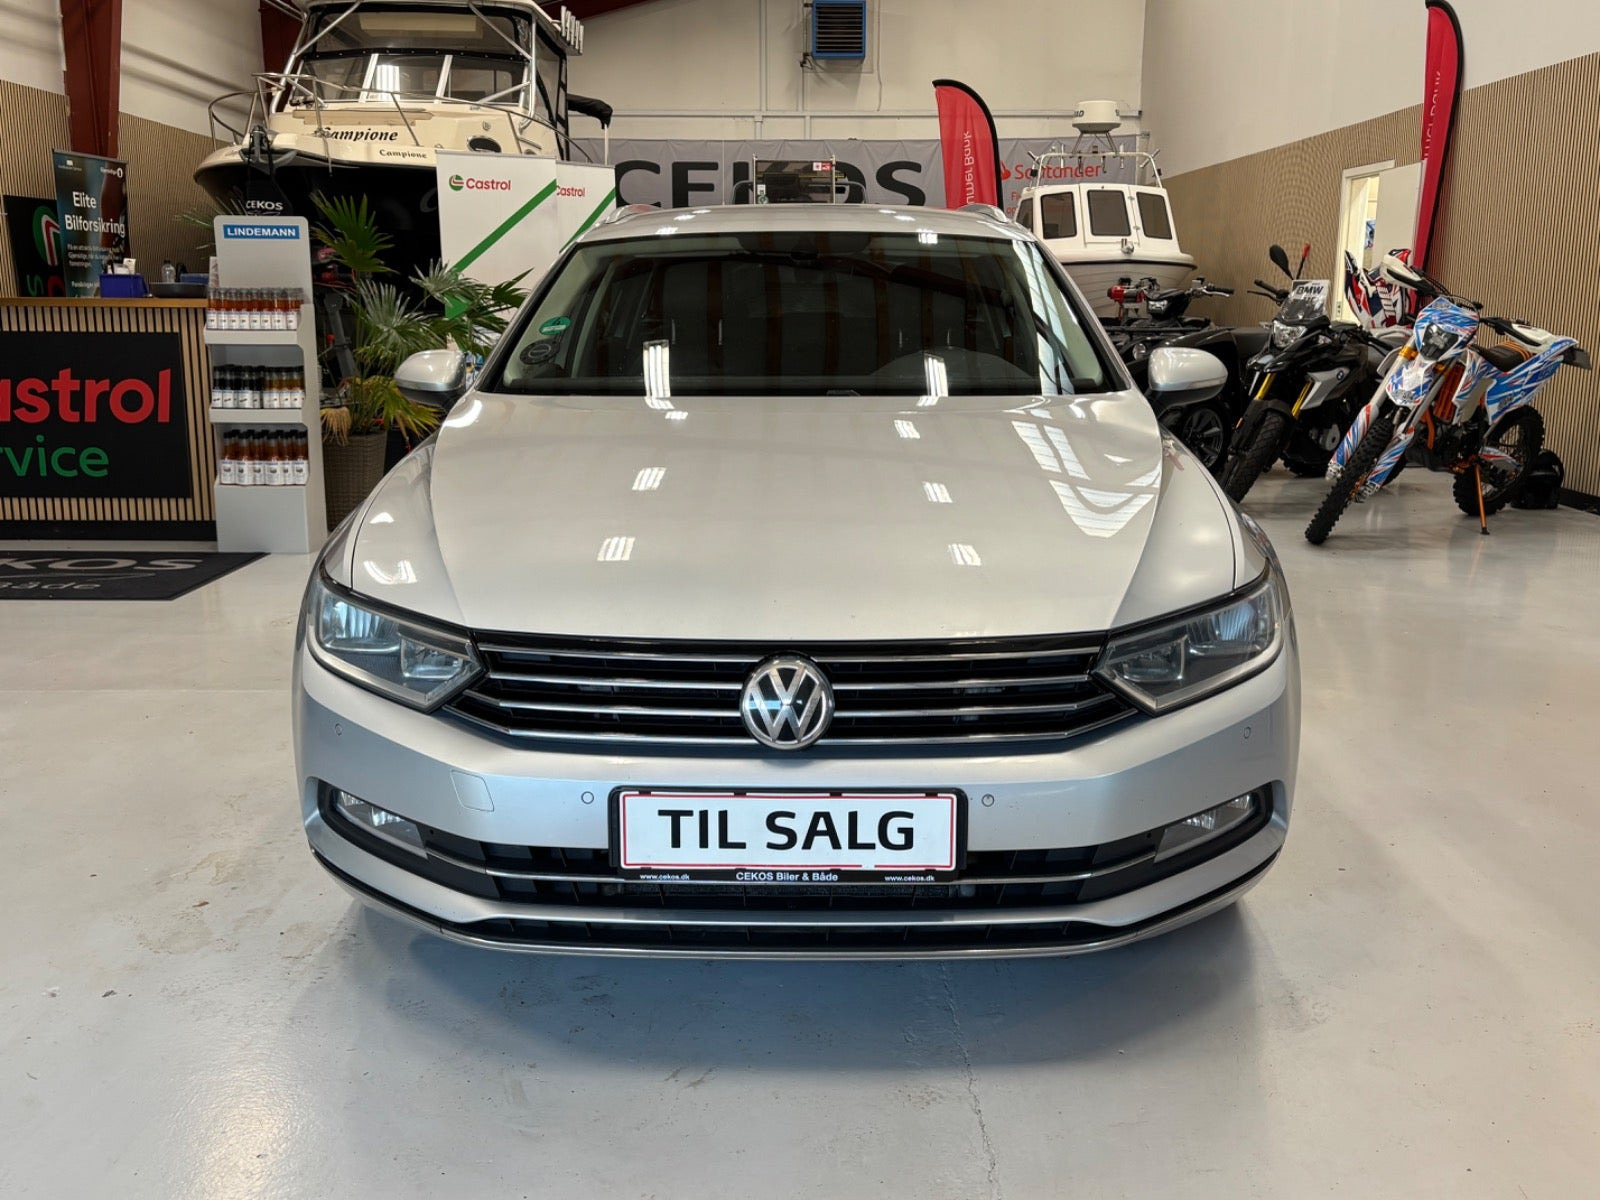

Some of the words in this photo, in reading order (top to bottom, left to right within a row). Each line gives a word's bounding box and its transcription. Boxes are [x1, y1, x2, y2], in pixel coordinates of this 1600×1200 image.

[379, 149, 427, 159] Campione
[466, 178, 511, 191] Castrol
[73, 191, 97, 209] Elite
[246, 200, 284, 211] CEKOS
[65, 215, 126, 238] Bilforsikring
[227, 228, 296, 237] LINDEMANN
[0, 434, 109, 478] vice
[658, 809, 747, 849] TIL
[765, 810, 915, 851] SALG
[640, 873, 690, 881] www.cekos.dk
[735, 871, 773, 881] CEKOS
[776, 872, 799, 882] Biler
[802, 872, 809, 882] &
[811, 871, 839, 882] Både
